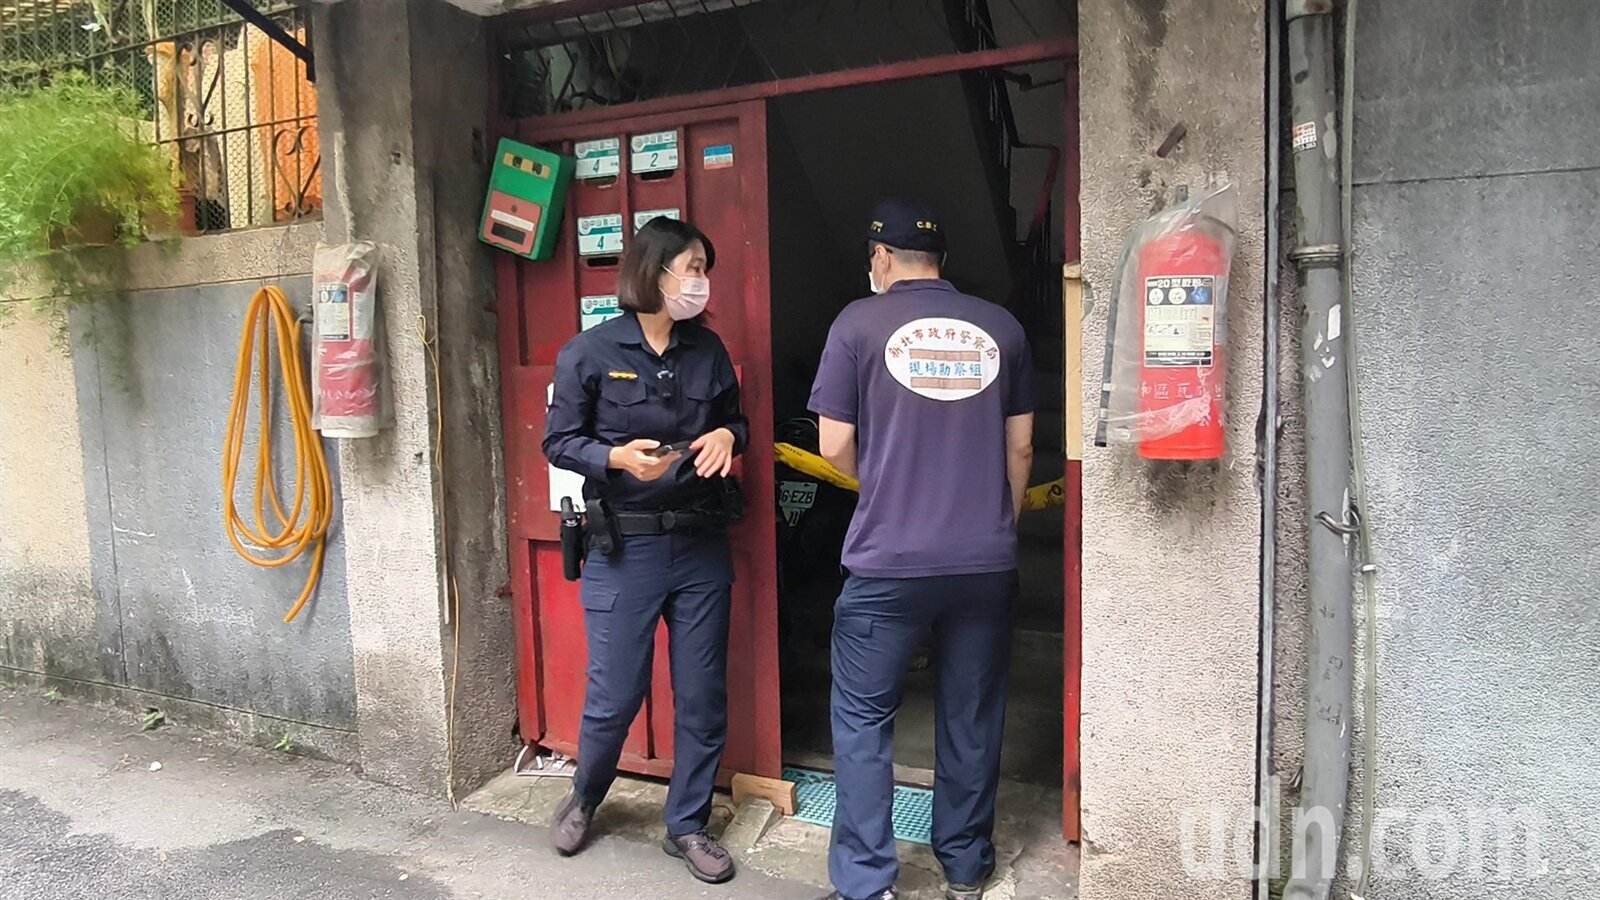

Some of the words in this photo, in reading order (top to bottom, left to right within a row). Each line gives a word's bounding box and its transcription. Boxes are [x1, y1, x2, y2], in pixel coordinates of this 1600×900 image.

[593, 159, 600, 173] 4
[650, 153, 659, 167] 2
[597, 236, 604, 249] 4
[888, 327, 998, 360] 新北市政府警察局
[909, 361, 982, 377] 現場勘察組
